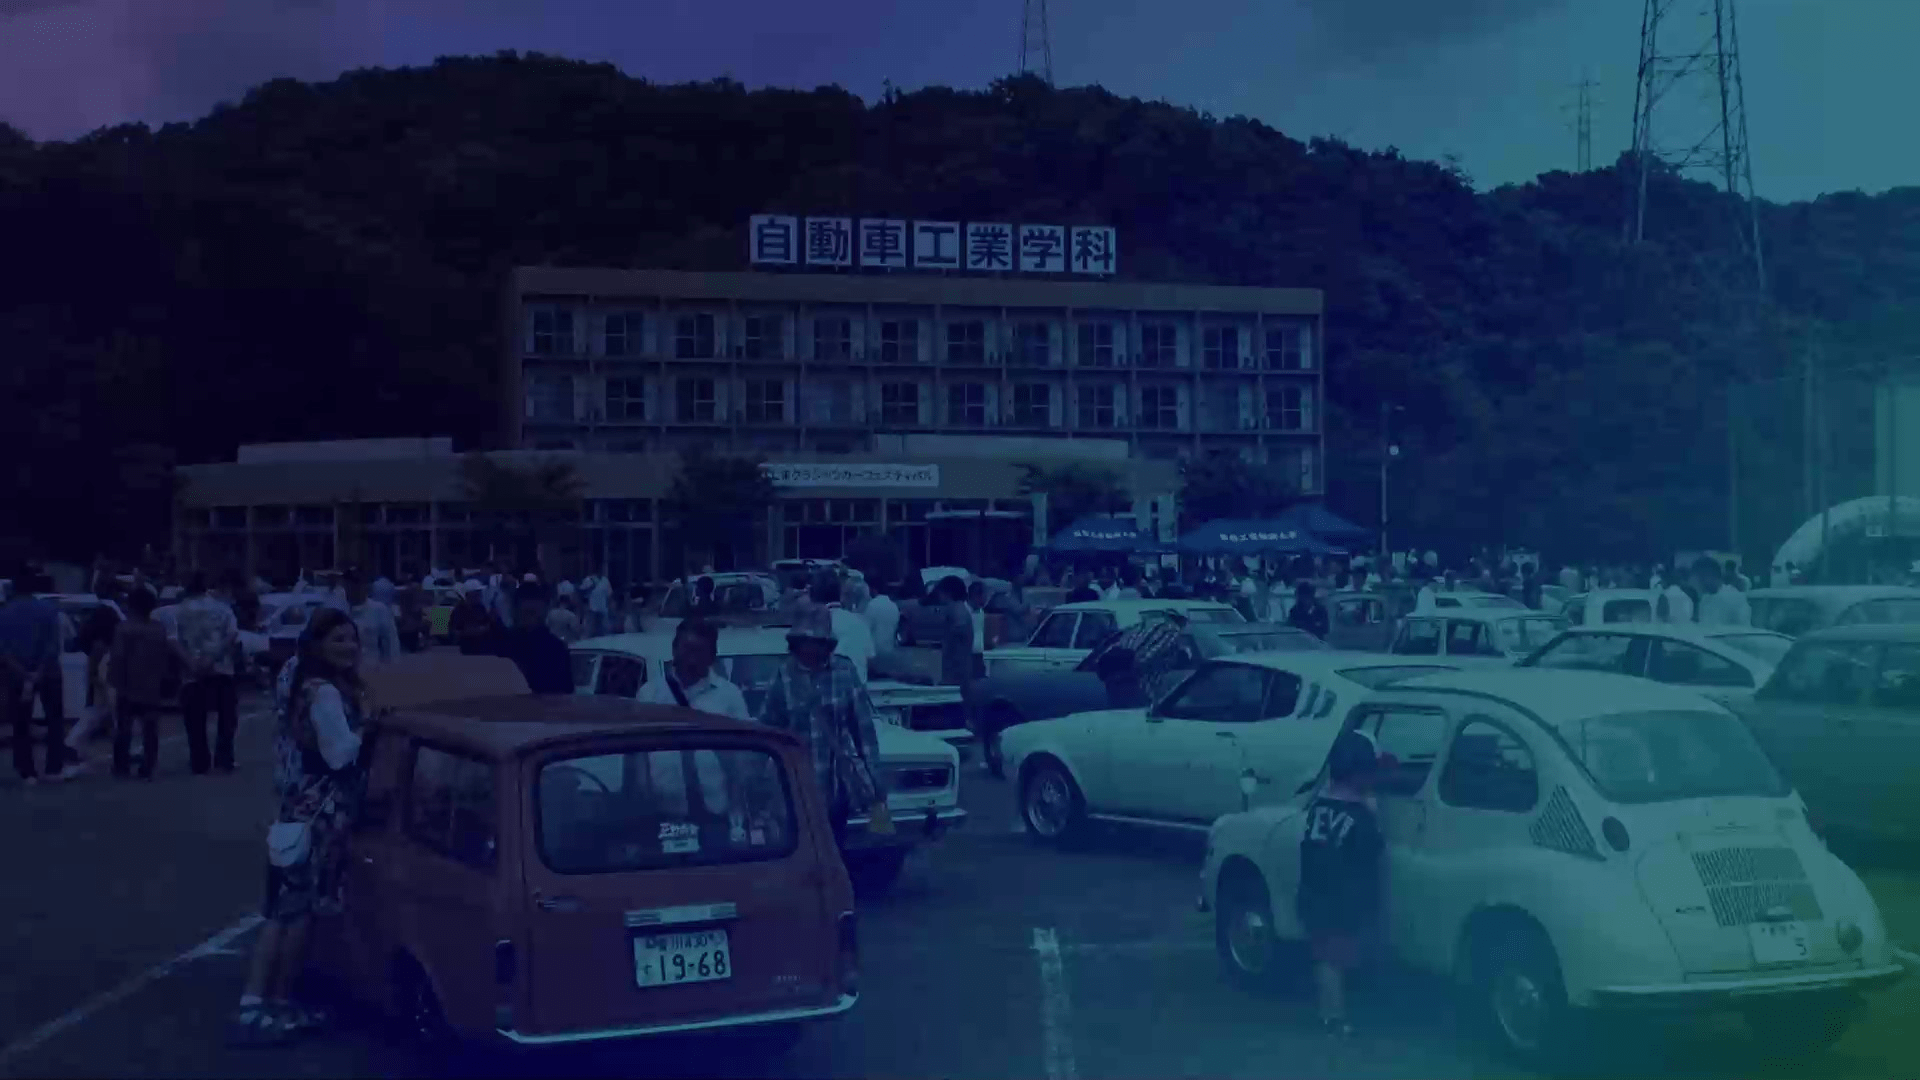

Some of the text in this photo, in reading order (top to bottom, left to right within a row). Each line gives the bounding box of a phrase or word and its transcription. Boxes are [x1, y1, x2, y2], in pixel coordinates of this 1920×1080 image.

[756, 216, 1115, 272] 自動車工業学科
[660, 949, 726, 982] 19-68
